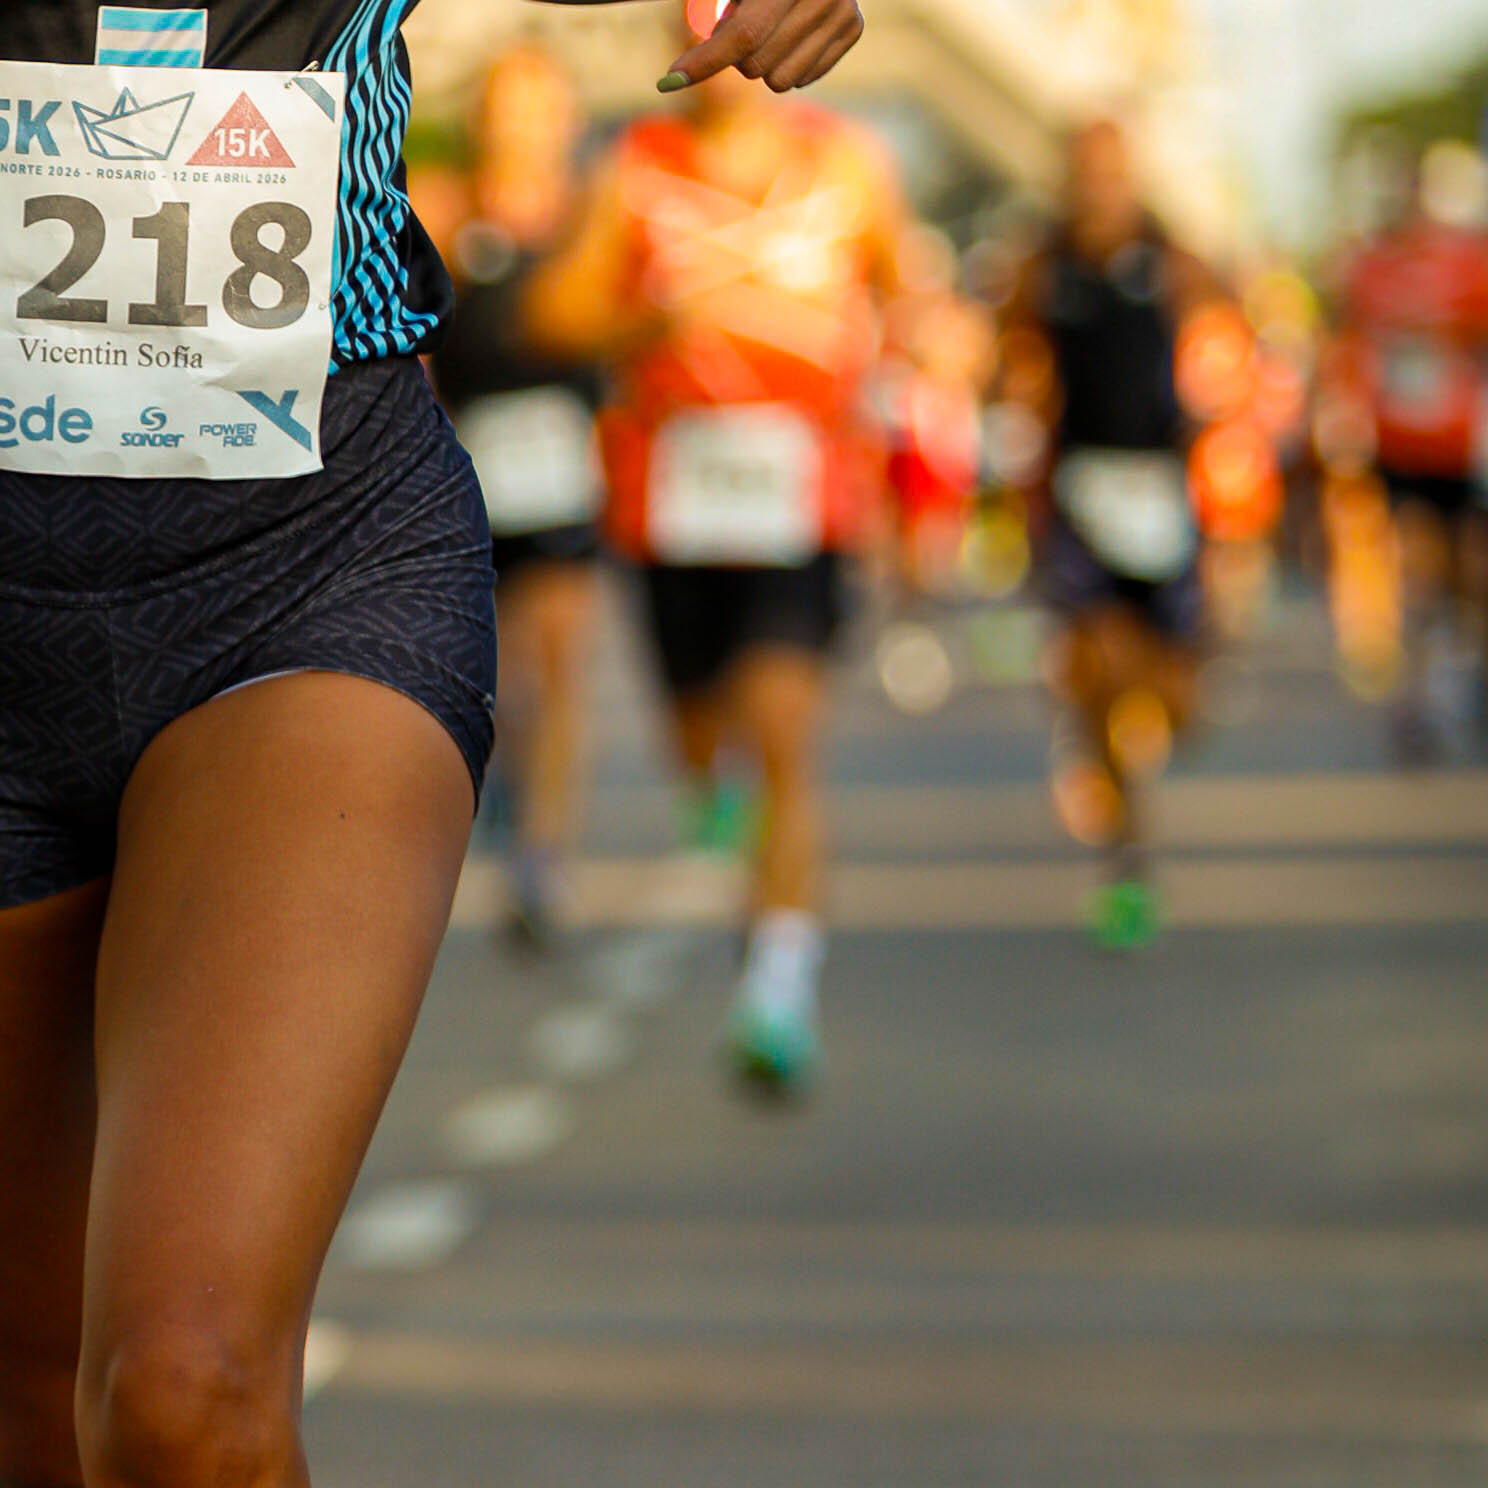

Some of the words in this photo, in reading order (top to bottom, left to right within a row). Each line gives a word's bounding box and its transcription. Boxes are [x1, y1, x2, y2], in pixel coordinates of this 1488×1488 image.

[214, 128, 271, 159] 15K
[0, 162, 43, 176] NORTE
[48, 166, 81, 178] 2026
[96, 168, 156, 181] ROSARIO
[173, 172, 187, 182] 12
[193, 172, 209, 182] DE
[214, 173, 251, 184] ABRIL
[257, 173, 287, 184] 2026
[18, 337, 128, 366] Vicentin
[199, 423, 257, 437] POWER
